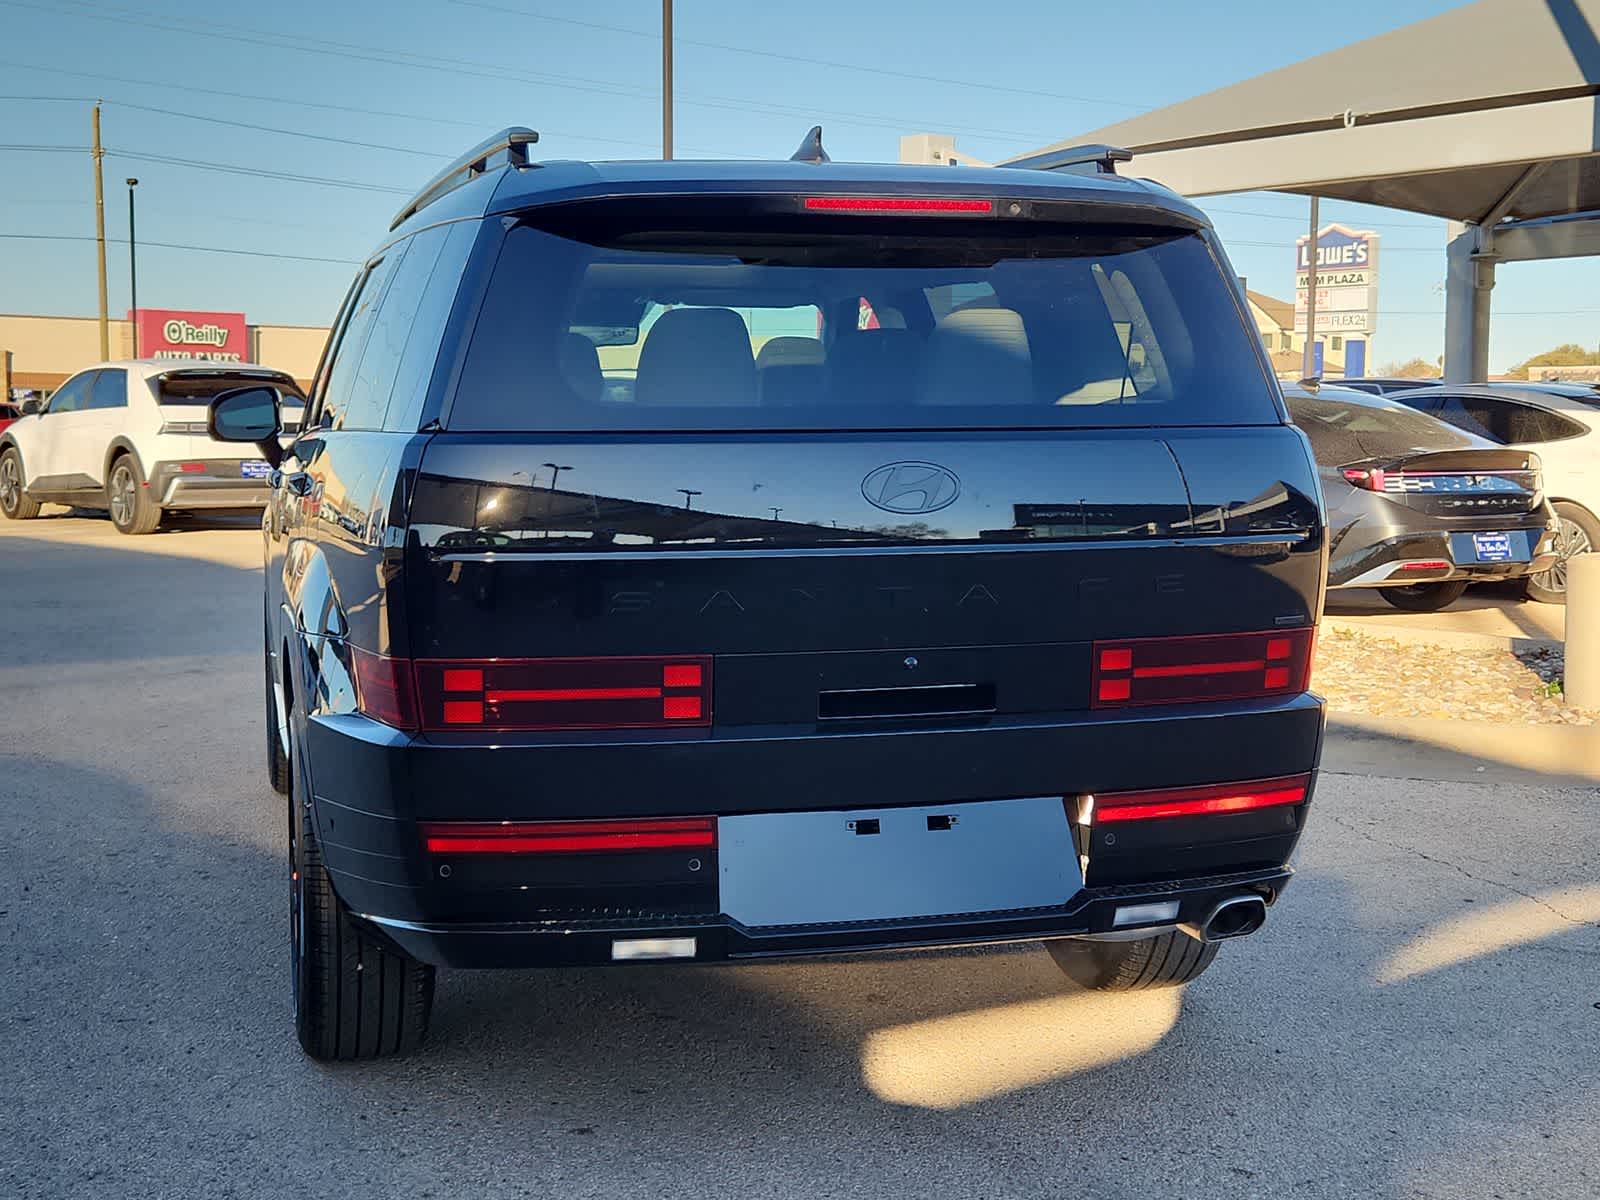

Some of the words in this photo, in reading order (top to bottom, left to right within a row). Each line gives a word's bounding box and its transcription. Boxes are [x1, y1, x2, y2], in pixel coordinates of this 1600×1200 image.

[1301, 242, 1368, 266] LOWE'S
[1327, 274, 1364, 284] PLAZA
[165, 321, 227, 345] O'Reilly
